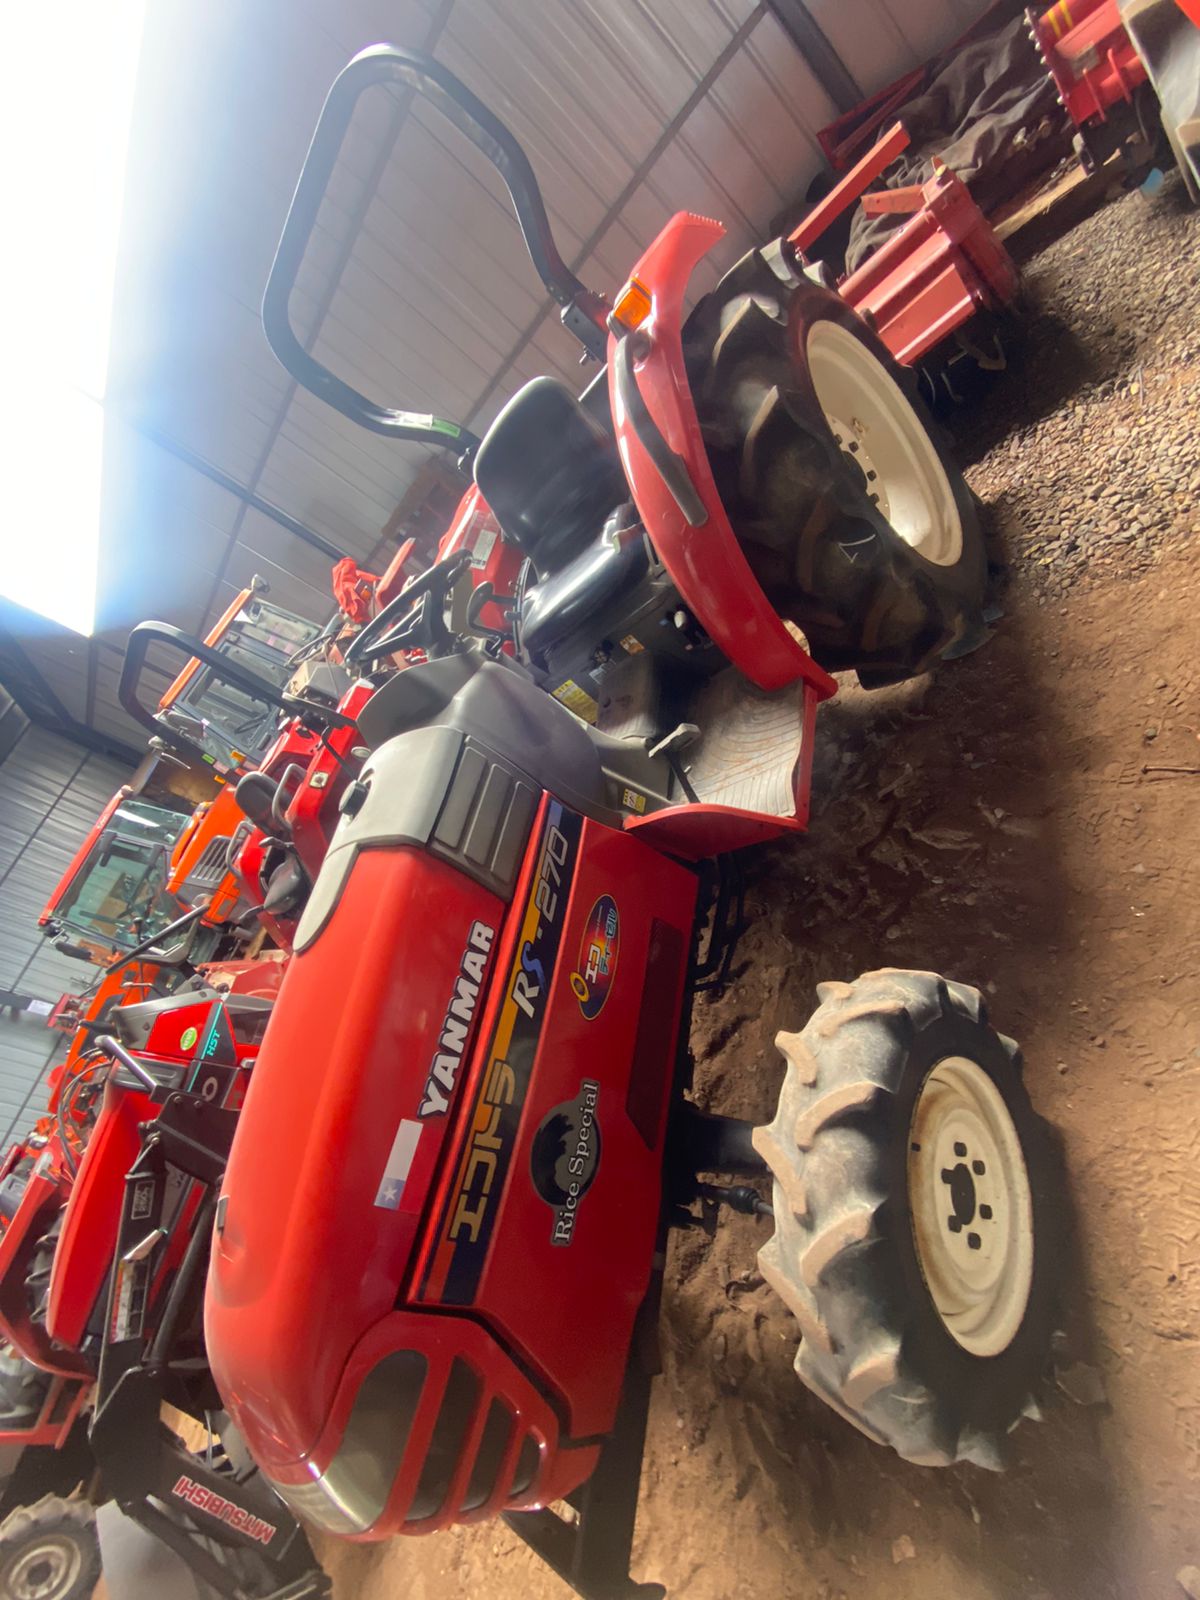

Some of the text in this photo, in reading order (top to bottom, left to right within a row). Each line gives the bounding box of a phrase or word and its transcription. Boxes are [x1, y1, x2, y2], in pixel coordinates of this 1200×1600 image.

[418, 920, 495, 1118] YANMAR
[584, 943, 601, 984] エコ
[206, 1030, 220, 1056] HST
[450, 1059, 516, 1243] エコトラ
[554, 1081, 599, 1243] Rice Special
[173, 1475, 276, 1546] MITSUBISHI
